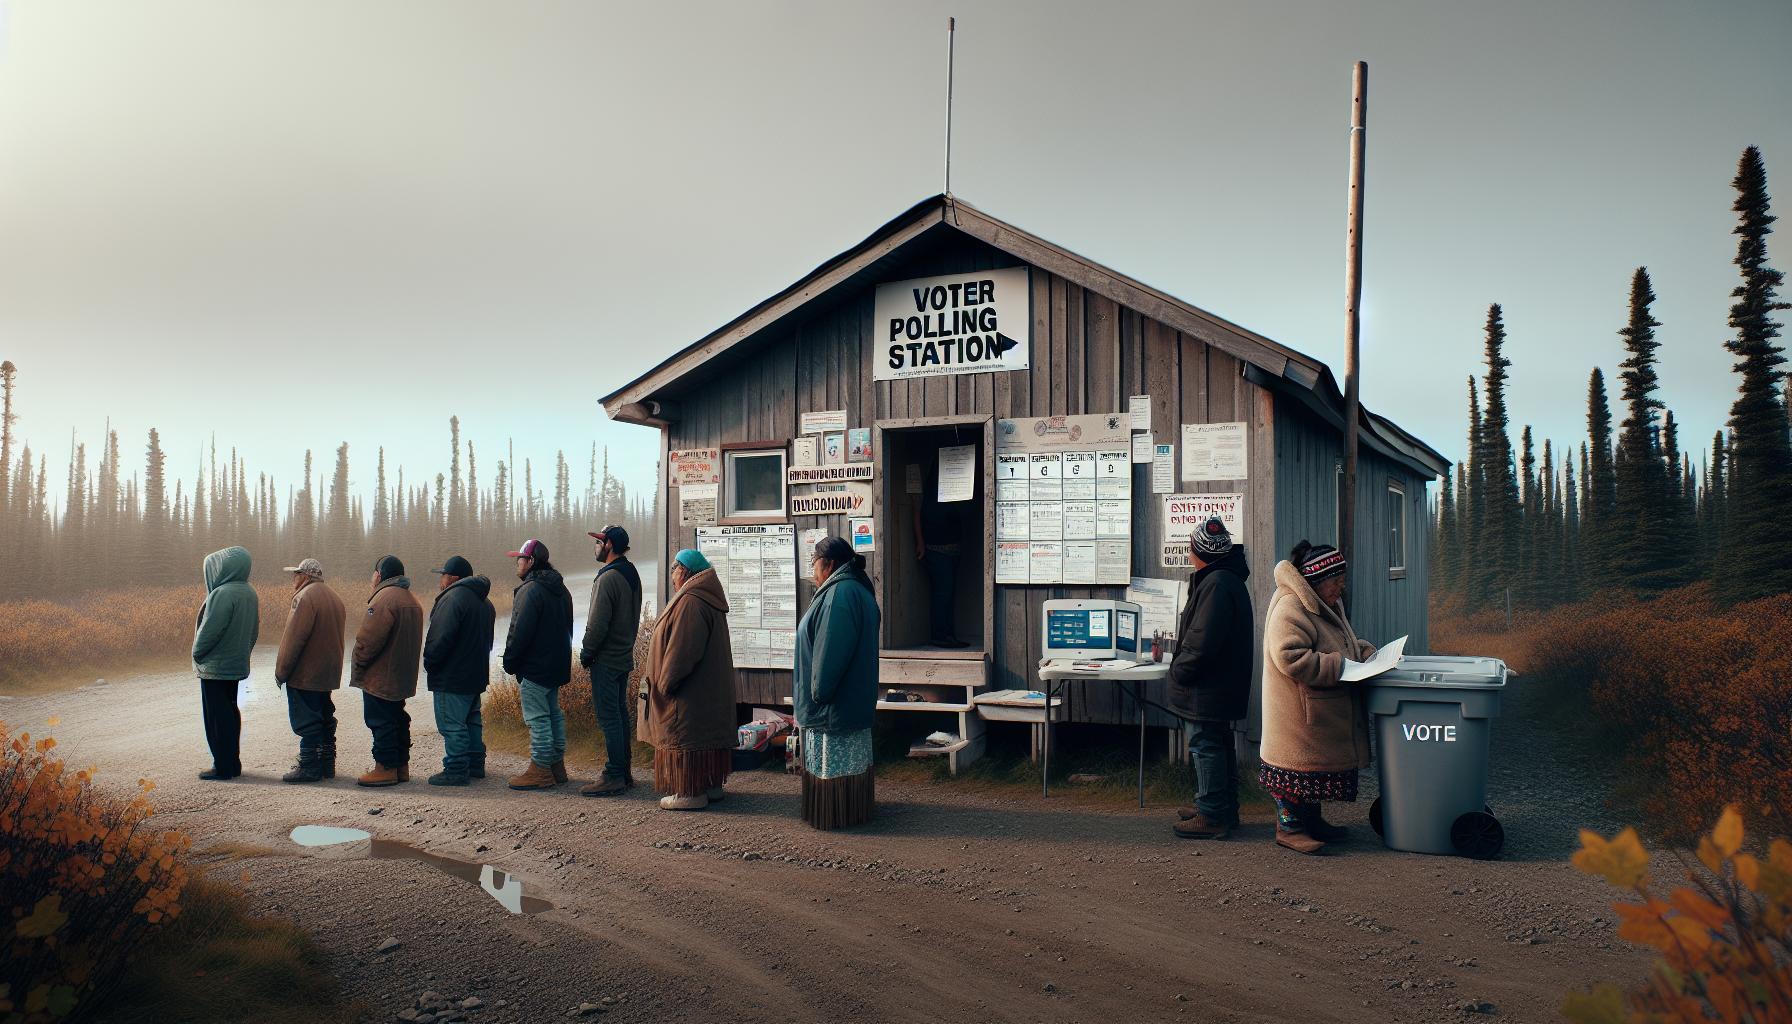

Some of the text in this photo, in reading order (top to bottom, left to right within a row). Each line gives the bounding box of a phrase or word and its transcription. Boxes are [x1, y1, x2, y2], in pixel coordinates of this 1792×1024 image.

[912, 279, 995, 312] VOTER
[890, 307, 997, 342] POLLING
[889, 334, 1003, 369] STATION
[1402, 724, 1457, 742] VOTE
